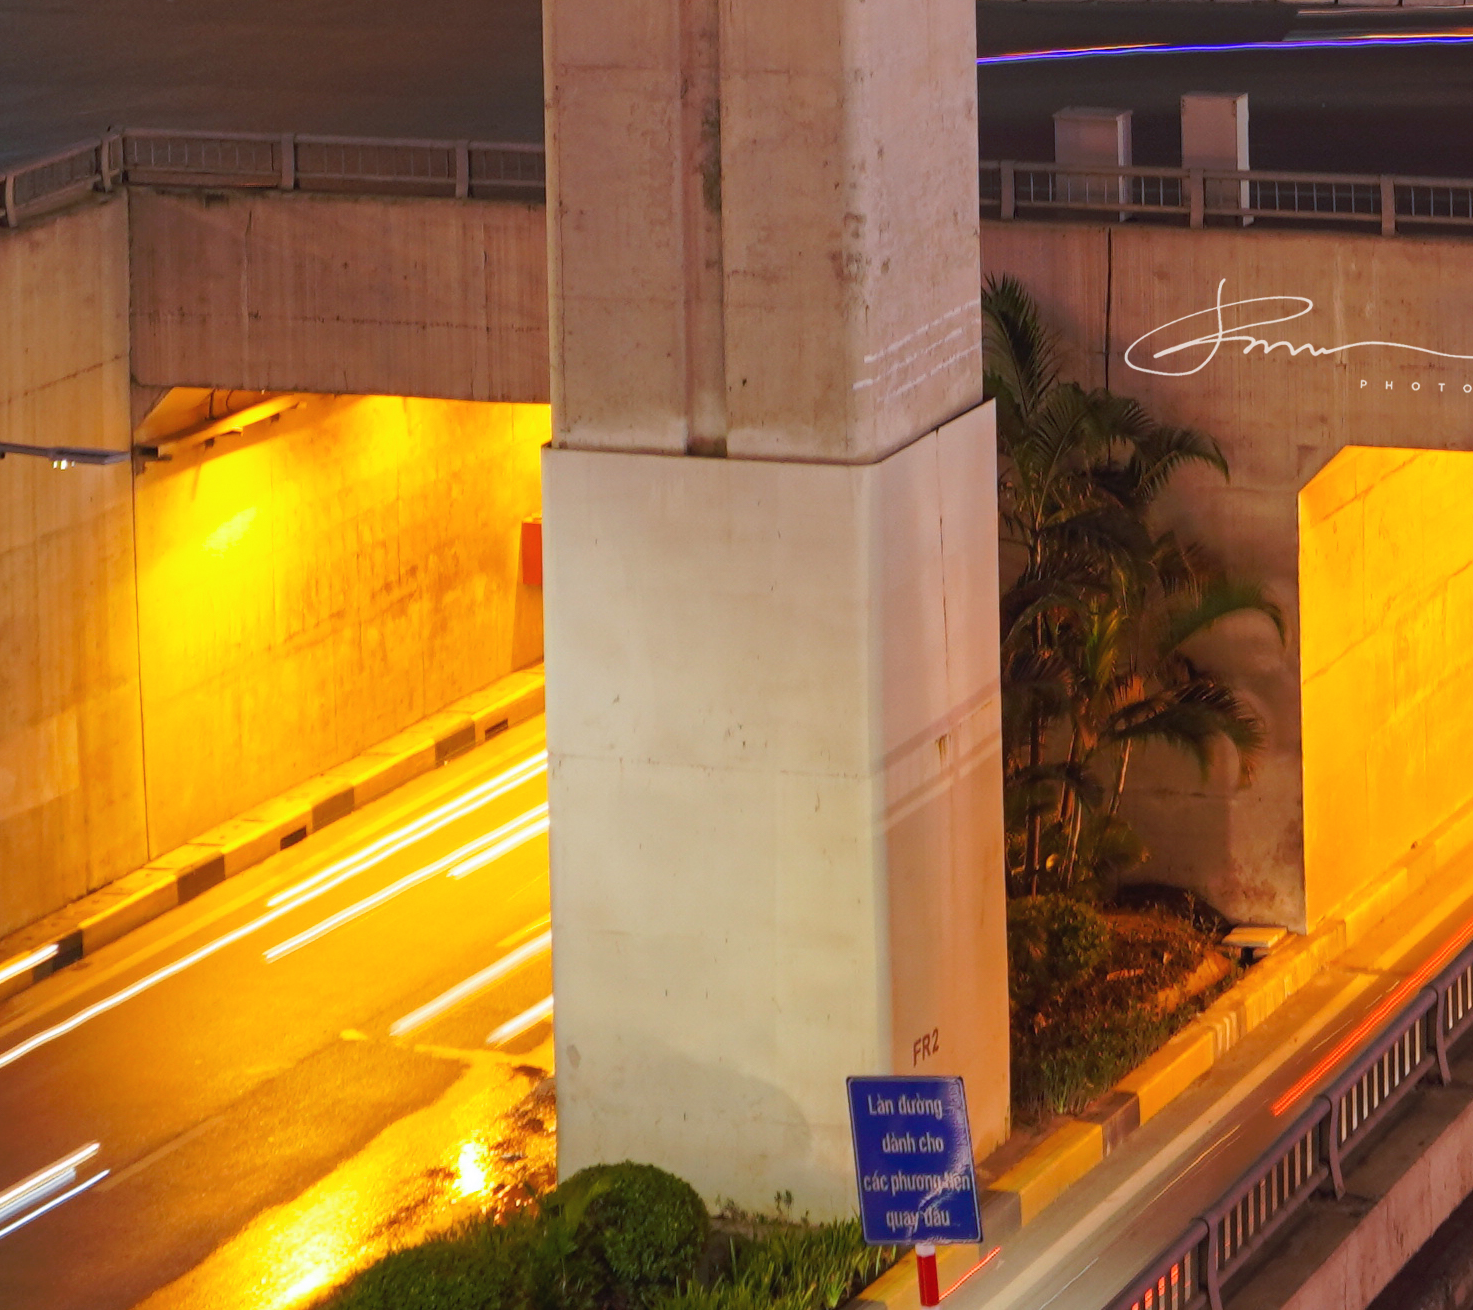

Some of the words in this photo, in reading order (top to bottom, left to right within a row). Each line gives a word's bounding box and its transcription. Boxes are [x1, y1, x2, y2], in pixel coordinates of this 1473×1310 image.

[913, 1028, 939, 1067] FR2
[919, 1132, 944, 1153] cho
[864, 1171, 888, 1192] các
